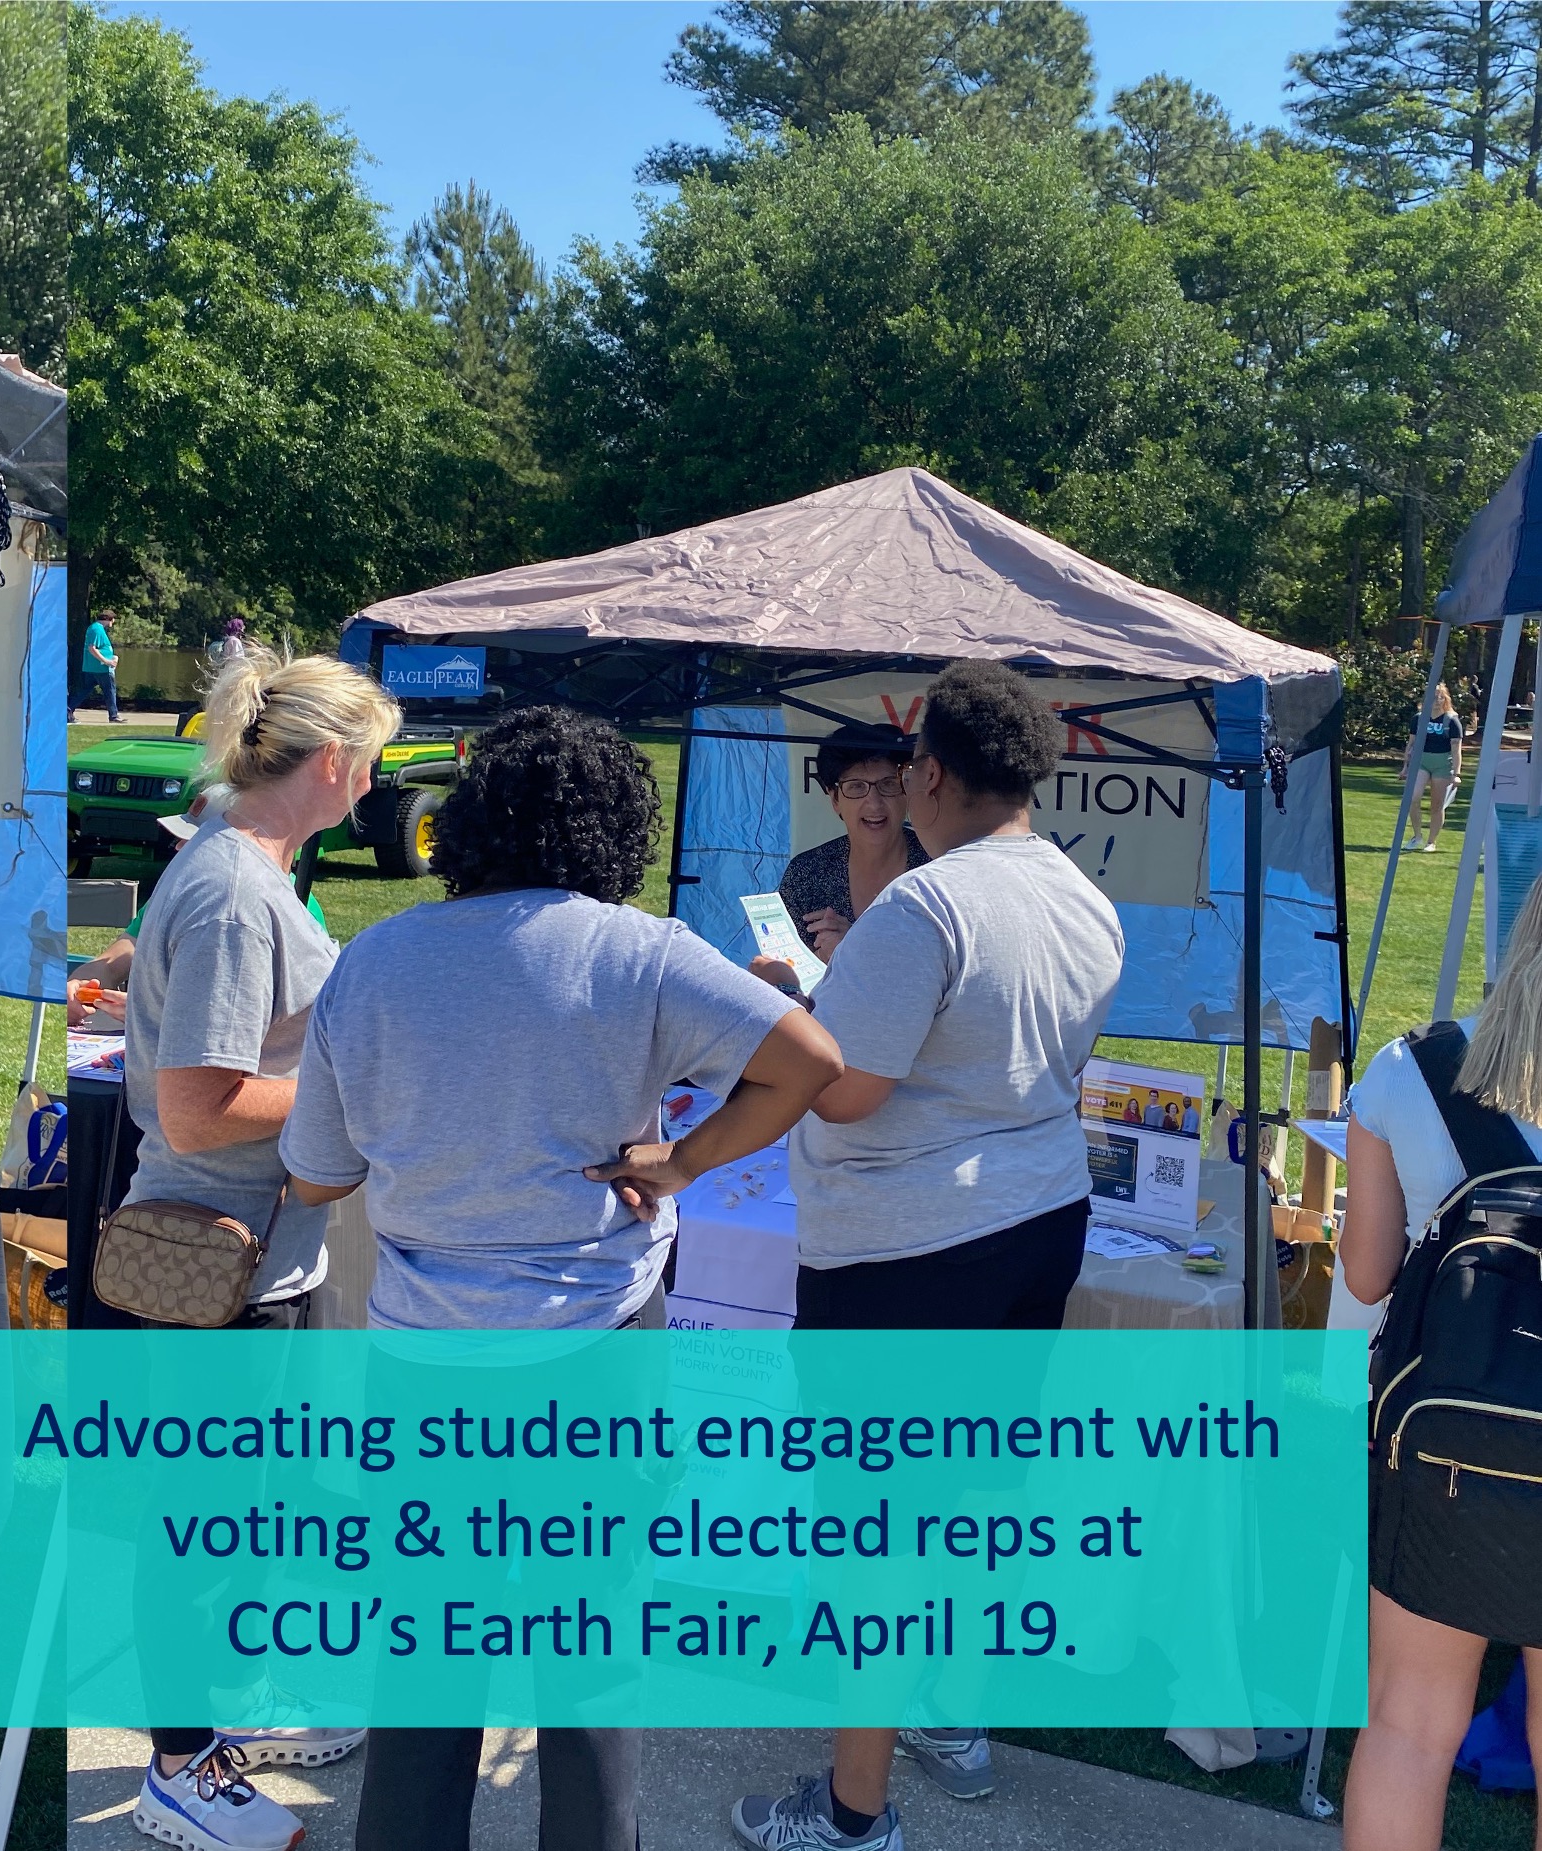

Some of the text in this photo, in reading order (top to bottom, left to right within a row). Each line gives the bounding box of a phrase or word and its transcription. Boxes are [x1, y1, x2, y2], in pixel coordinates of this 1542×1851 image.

[387, 670, 476, 684] EAGLE PEAK
[1085, 1096, 1123, 1109] VOTE 411
[668, 1317, 714, 1336] AGUE
[669, 1334, 715, 1356] OMEN
